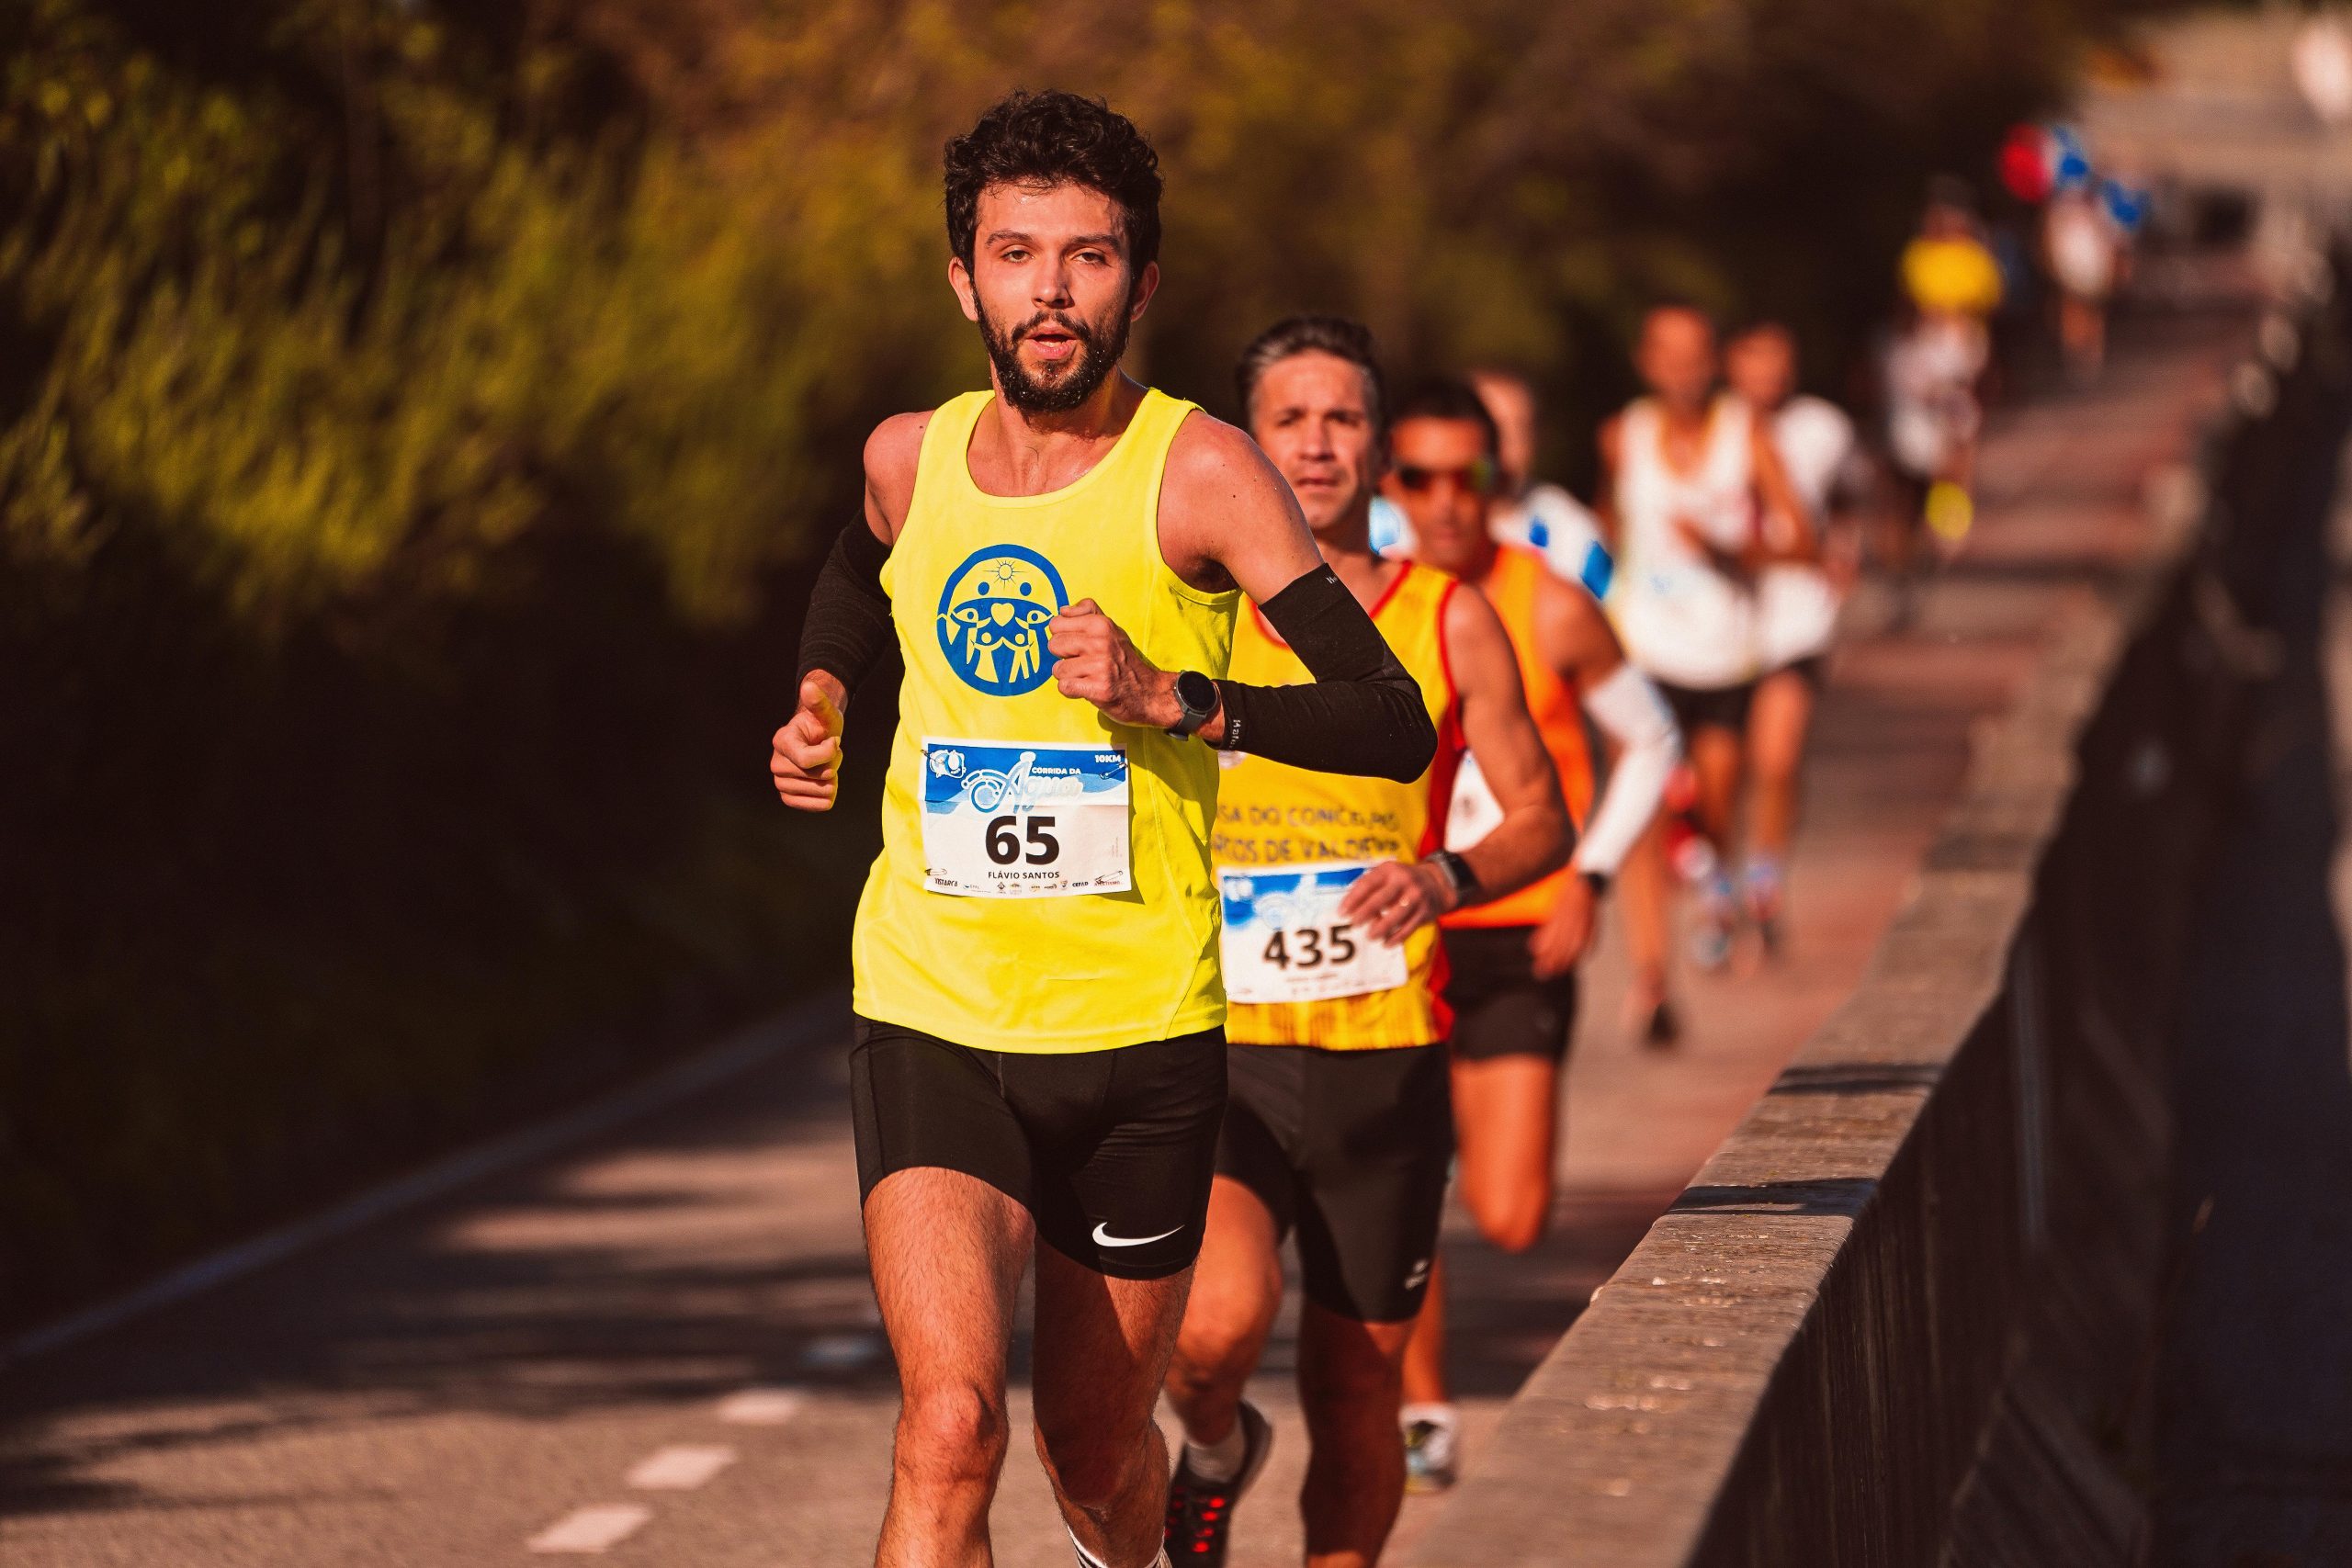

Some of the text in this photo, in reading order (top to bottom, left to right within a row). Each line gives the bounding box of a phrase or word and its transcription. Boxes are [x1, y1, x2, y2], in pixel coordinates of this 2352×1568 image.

[1094, 754, 1122, 763] 10KM
[1250, 806, 1281, 826] DO
[985, 815, 1060, 865] 65
[1265, 837, 1293, 862] DE
[988, 870, 1060, 879] FLÁVIO SANTOS
[1262, 924, 1357, 970] 435
